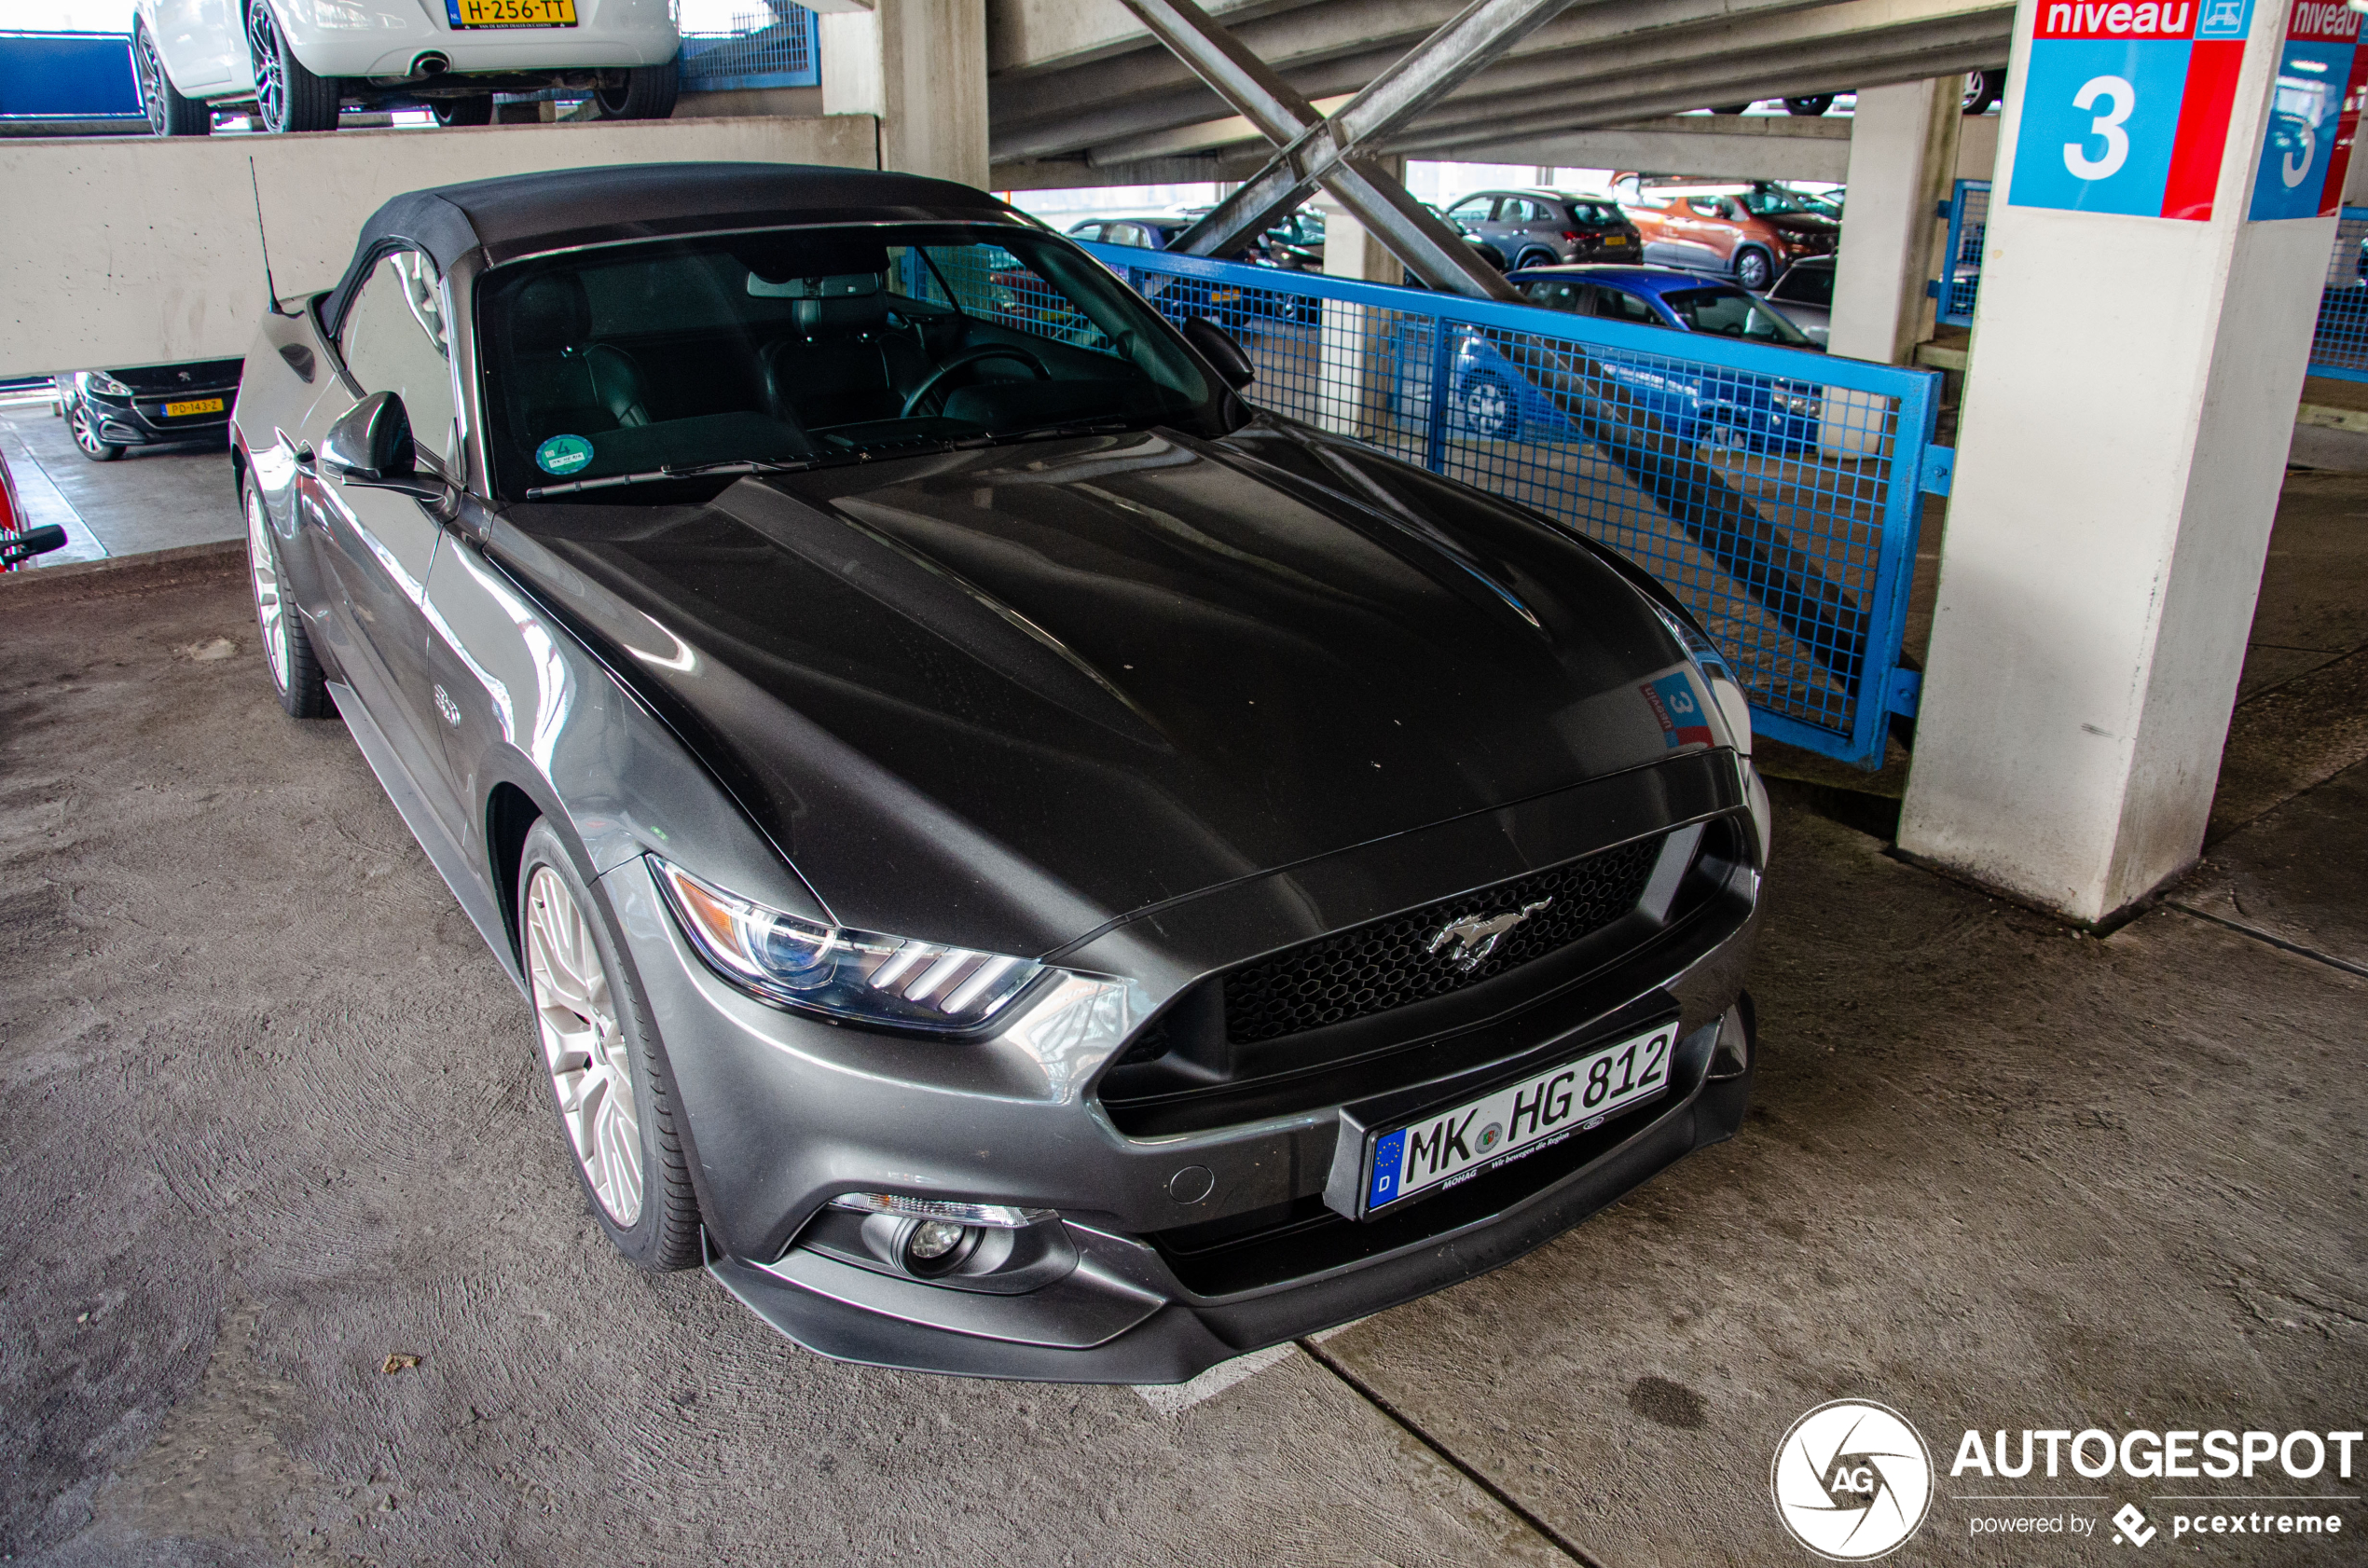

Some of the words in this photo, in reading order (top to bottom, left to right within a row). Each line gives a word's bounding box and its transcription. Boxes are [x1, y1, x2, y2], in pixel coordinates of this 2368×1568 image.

[468, 0, 564, 20] H-256-TT
[2046, 0, 2190, 34] niveau
[2292, 1, 2361, 35] niveau
[2063, 75, 2136, 180] 3
[171, 400, 218, 415] PD-143-Z
[558, 441, 571, 454] 4
[1405, 1107, 1479, 1185] MK
[1507, 1070, 1576, 1143] HG
[1582, 1033, 1668, 1108] 812
[1492, 1158, 1506, 1169] Wir
[1505, 1146, 1535, 1164] bewegen
[1535, 1139, 1547, 1151] die
[1547, 1132, 1570, 1147] Region
[1378, 1175, 1390, 1193] D
[1442, 1168, 1478, 1190] MOHAG
